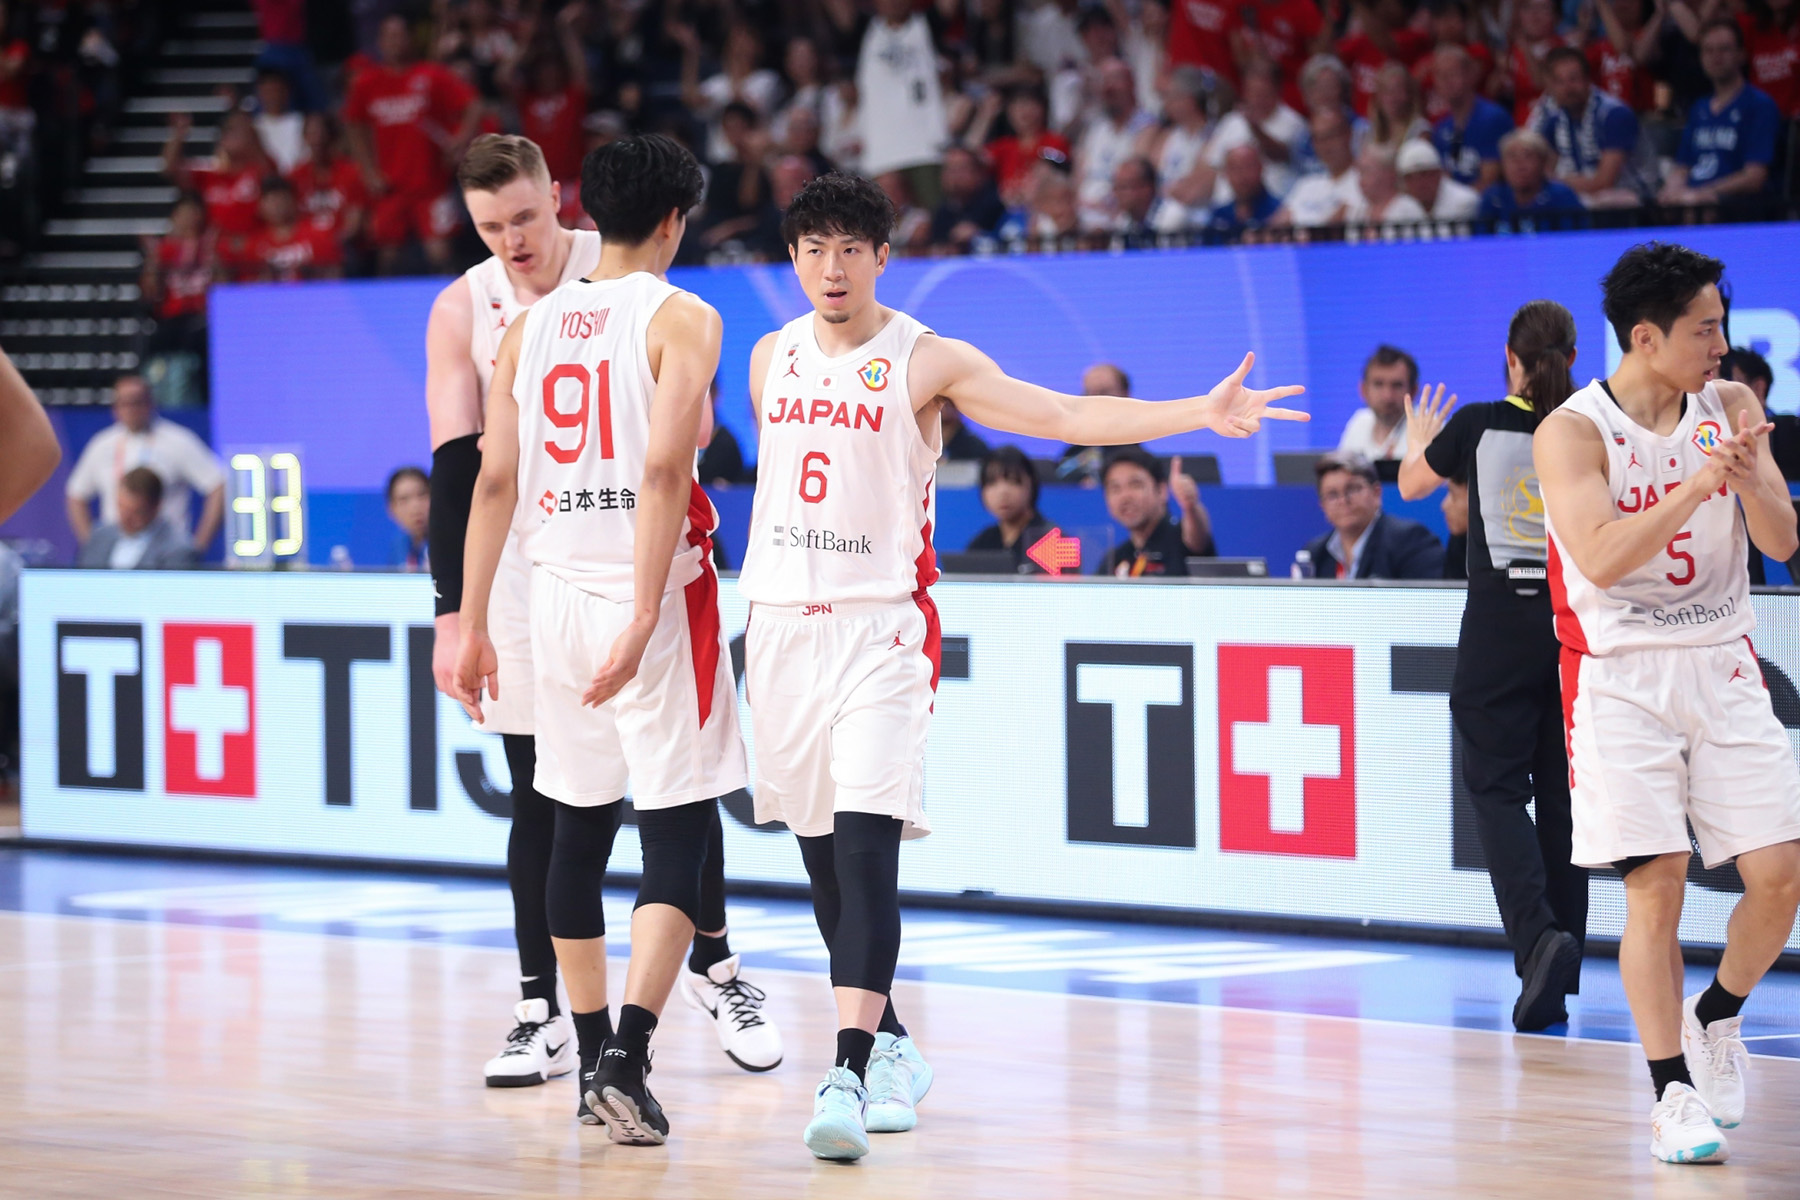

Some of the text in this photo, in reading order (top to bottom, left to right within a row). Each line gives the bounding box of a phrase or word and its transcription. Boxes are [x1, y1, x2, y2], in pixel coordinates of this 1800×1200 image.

[542, 359, 615, 464] 91
[768, 397, 884, 433] JAPAN
[559, 487, 636, 512] 日本生命
[798, 451, 831, 504] 6
[230, 452, 303, 557] 33
[789, 526, 872, 554] SoftBank
[1666, 531, 1696, 586] 5
[801, 603, 833, 617] JPN
